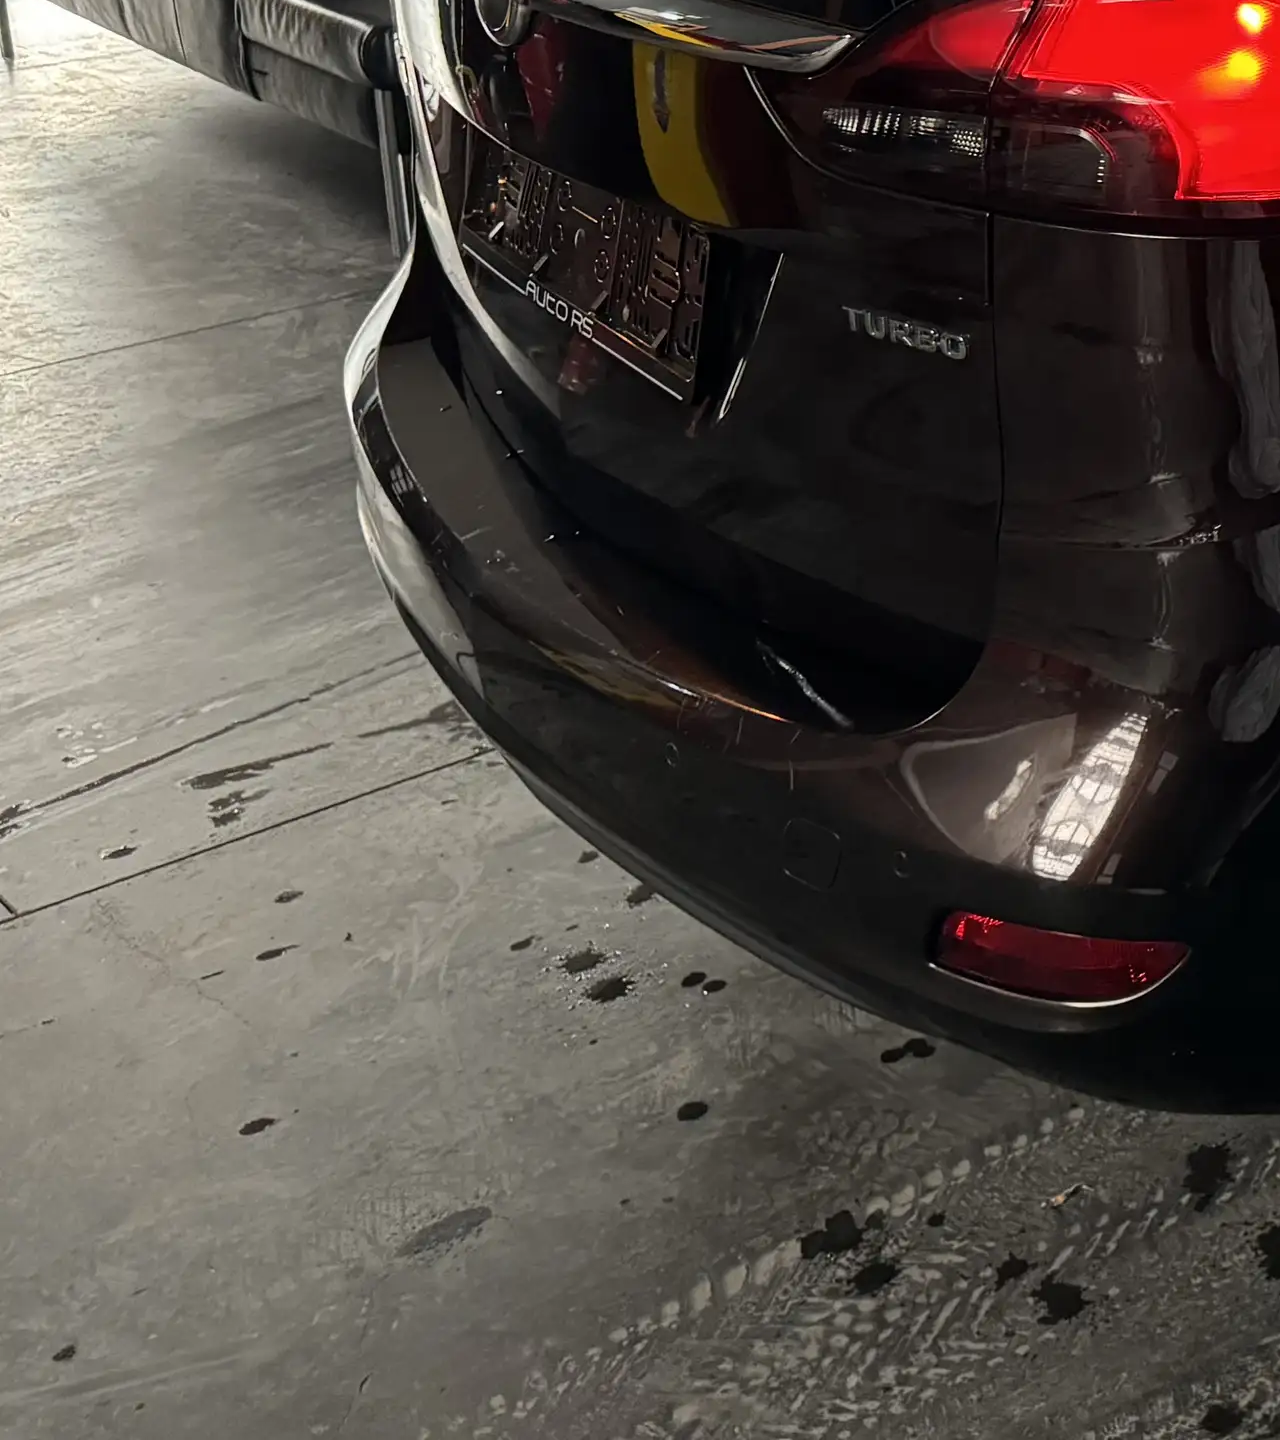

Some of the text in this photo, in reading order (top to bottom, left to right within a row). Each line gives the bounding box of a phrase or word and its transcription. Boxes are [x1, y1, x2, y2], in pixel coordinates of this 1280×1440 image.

[525, 279, 595, 339] AUTO RS
[841, 305, 968, 360] TURBO
